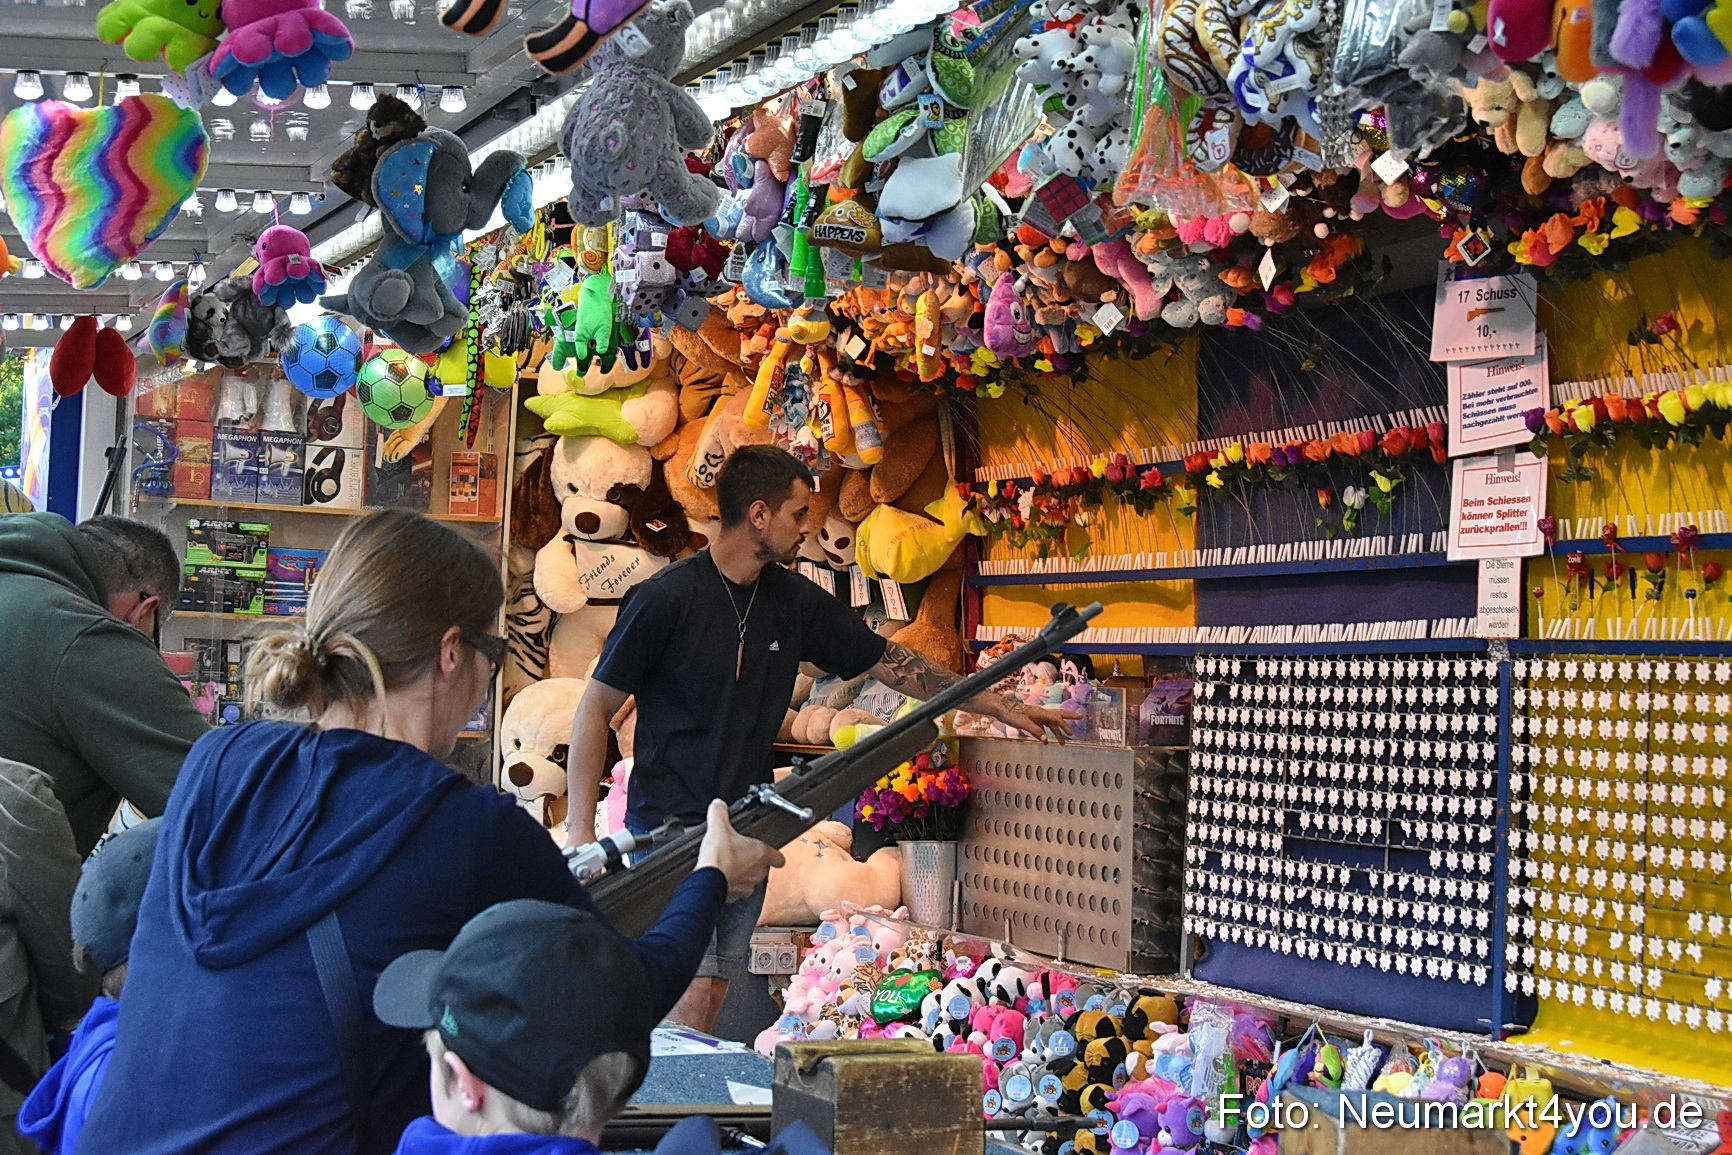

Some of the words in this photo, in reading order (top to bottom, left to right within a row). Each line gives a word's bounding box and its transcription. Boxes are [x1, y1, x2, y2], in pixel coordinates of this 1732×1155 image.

[814, 224, 866, 244] HAPPENS
[1458, 290, 1470, 303] 17
[1475, 287, 1517, 302] Schuss
[1476, 324, 1497, 339] 10,-
[1486, 358, 1525, 377] Hinweis!
[1462, 391, 1485, 400] Zähler
[1487, 385, 1506, 395] steht
[1507, 381, 1518, 391] auf
[1462, 401, 1474, 410] Bei
[1476, 398, 1494, 407] mehr
[1495, 387, 1538, 403] verbrauchten
[1462, 408, 1496, 419] Schüssen
[1498, 404, 1516, 412] muss
[217, 432, 258, 442] MEGAPHON
[263, 436, 303, 445] MEGAPHON
[1485, 471, 1521, 485] Hinweis!
[1462, 498, 1485, 507] Beim
[1487, 495, 1532, 506] Schiessen
[1461, 511, 1494, 521] können
[1496, 508, 1529, 520] Splitter
[1485, 560, 1495, 569] Die
[579, 554, 616, 590] Friends
[600, 557, 640, 593] Forever
[1488, 575, 1510, 584] müssen
[1490, 590, 1508, 599] restlos
[1479, 604, 1518, 616] abgeschossen
[1488, 620, 1509, 629] werden
[1149, 713, 1185, 726] FORTNITE
[873, 989, 902, 1002] YOU
